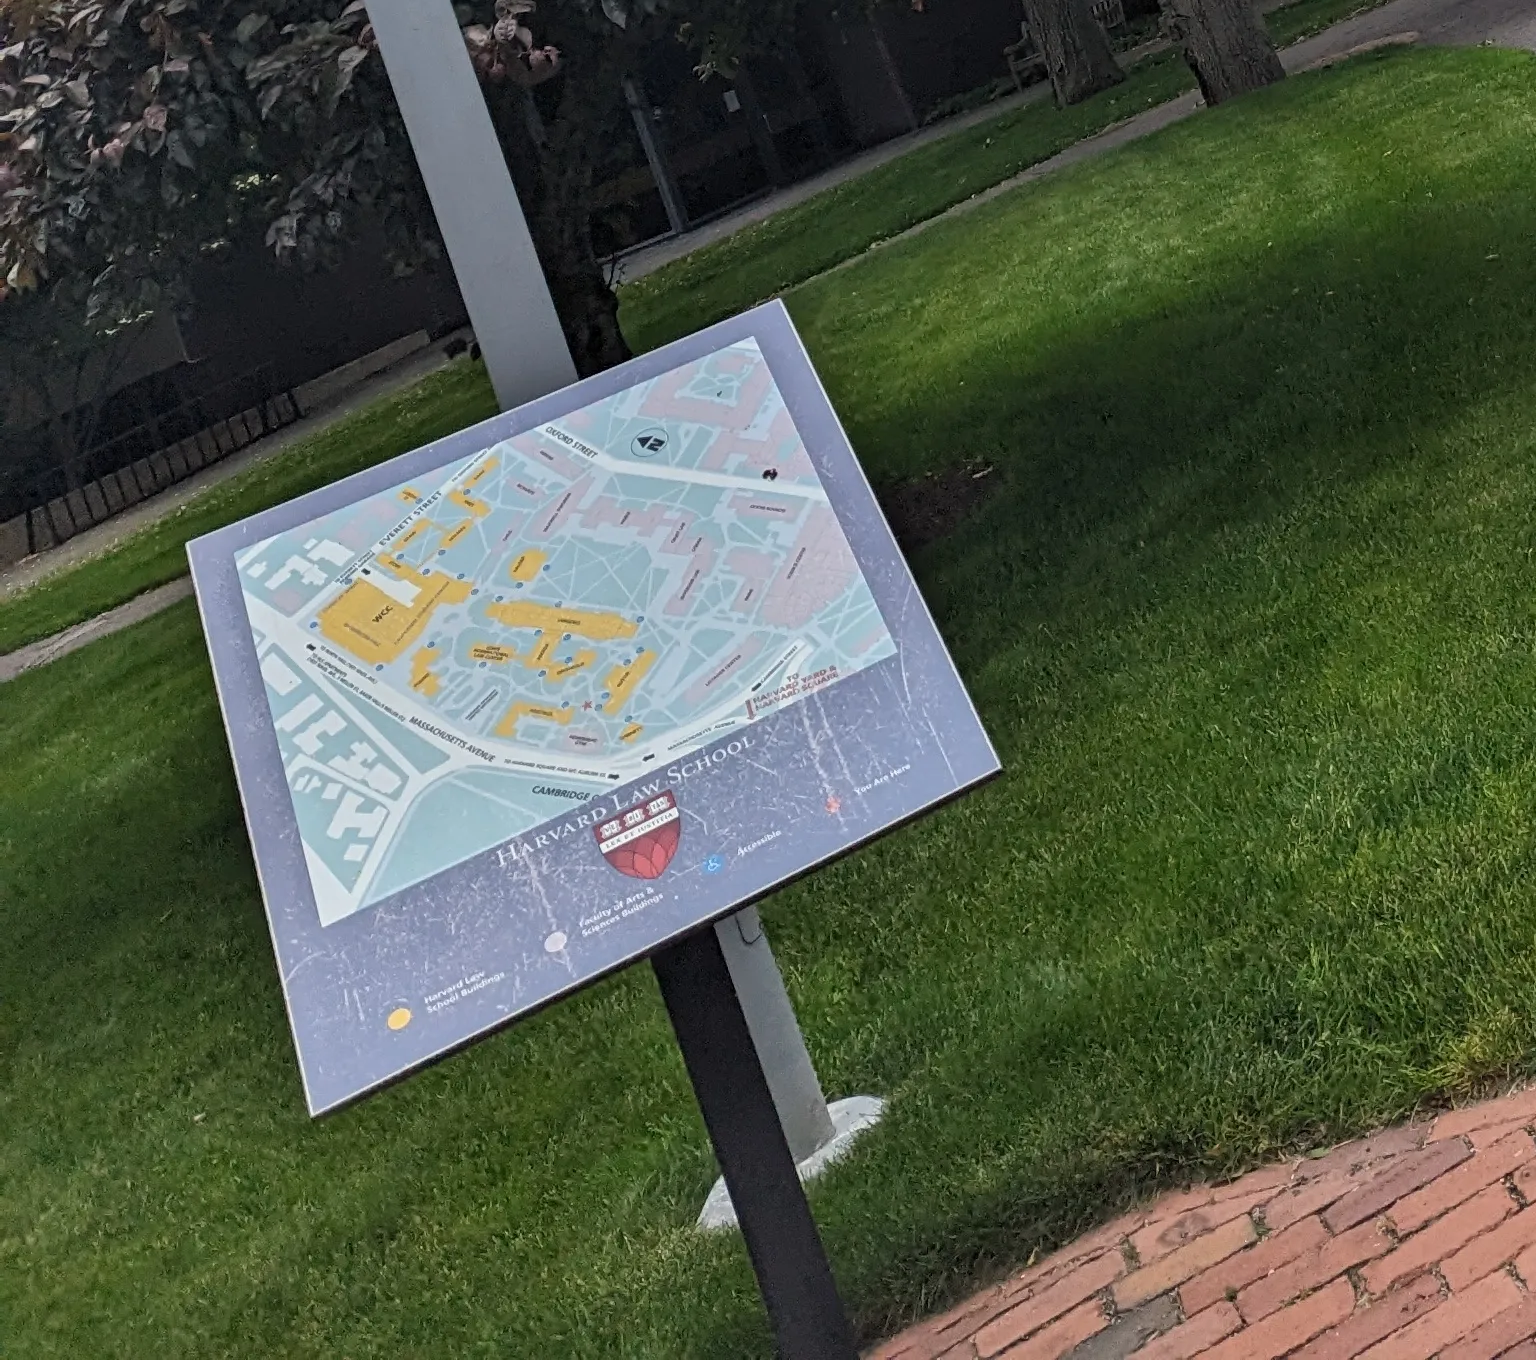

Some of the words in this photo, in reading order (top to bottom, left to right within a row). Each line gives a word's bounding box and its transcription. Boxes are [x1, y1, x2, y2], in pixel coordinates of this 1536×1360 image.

[546, 426, 573, 444] OXFORD
[572, 440, 598, 458] STREET
[647, 438, 665, 452] N
[379, 515, 413, 546] EVERETT
[413, 490, 442, 517] STREET
[372, 605, 393, 624] WCC
[752, 681, 799, 705] HARVARD
[800, 670, 827, 684] YARD
[786, 672, 800, 682] TO
[409, 716, 468, 749] MASSACHUSETTS
[466, 744, 496, 763] AVENUE
[532, 786, 591, 801] CAMBRIDGE
[854, 783, 872, 796] You
[874, 775, 889, 786] Are
[890, 764, 911, 778] Here
[496, 804, 607, 868] HARVARD
[610, 779, 660, 810] LAW
[667, 736, 755, 785] SCHOOL
[737, 830, 782, 857] Accessible
[578, 906, 612, 930] Faculty
[613, 900, 624, 911] of
[626, 891, 645, 904] Arts
[646, 886, 654, 894] &
[581, 915, 620, 938] Sciences
[622, 893, 664, 917] Buildings
[424, 979, 463, 1004] Harvard
[465, 971, 486, 985] Law
[426, 994, 460, 1014] School
[461, 972, 505, 998] Buildings
